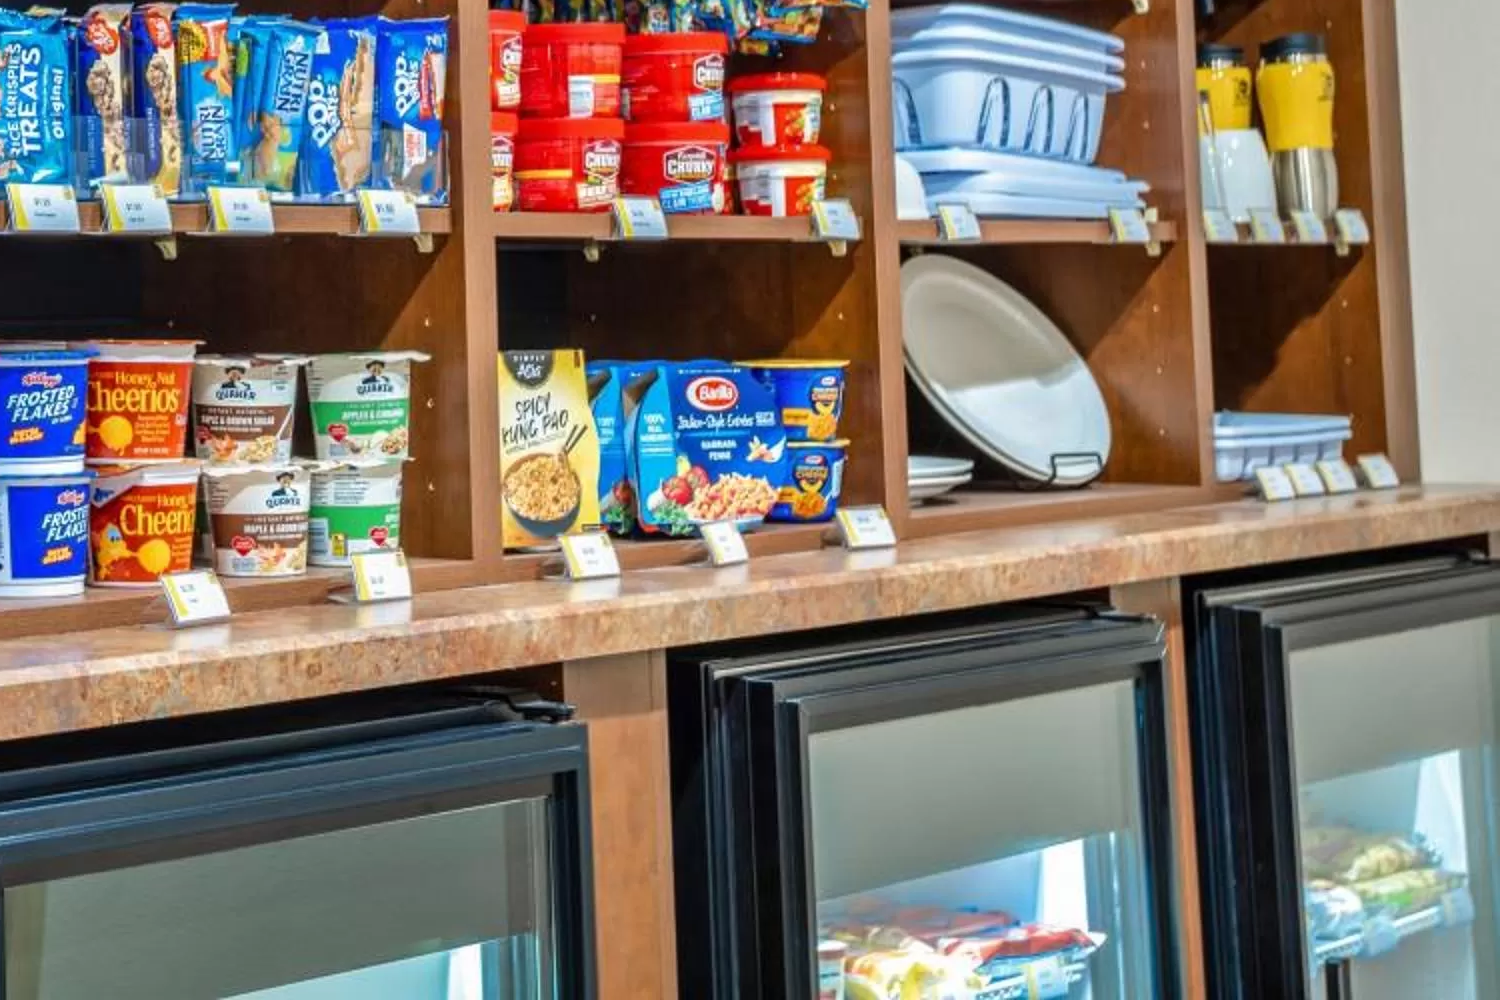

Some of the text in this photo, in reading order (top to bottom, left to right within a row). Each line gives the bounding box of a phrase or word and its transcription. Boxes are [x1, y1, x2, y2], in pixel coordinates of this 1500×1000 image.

[6, 43, 22, 118] KRISPIES
[22, 47, 41, 157] TREATS
[666, 158, 714, 175] CHUNKY
[114, 371, 176, 389] Honey Nut
[699, 385, 734, 399] Barilla
[6, 385, 76, 410] FROSTED
[86, 380, 182, 414] Cheerios
[515, 391, 551, 422] SPICY
[12, 403, 70, 423] FLAKES
[502, 409, 569, 448] KUNG PAO
[45, 523, 87, 542] FLAKE
[118, 502, 196, 536] Cheerio
